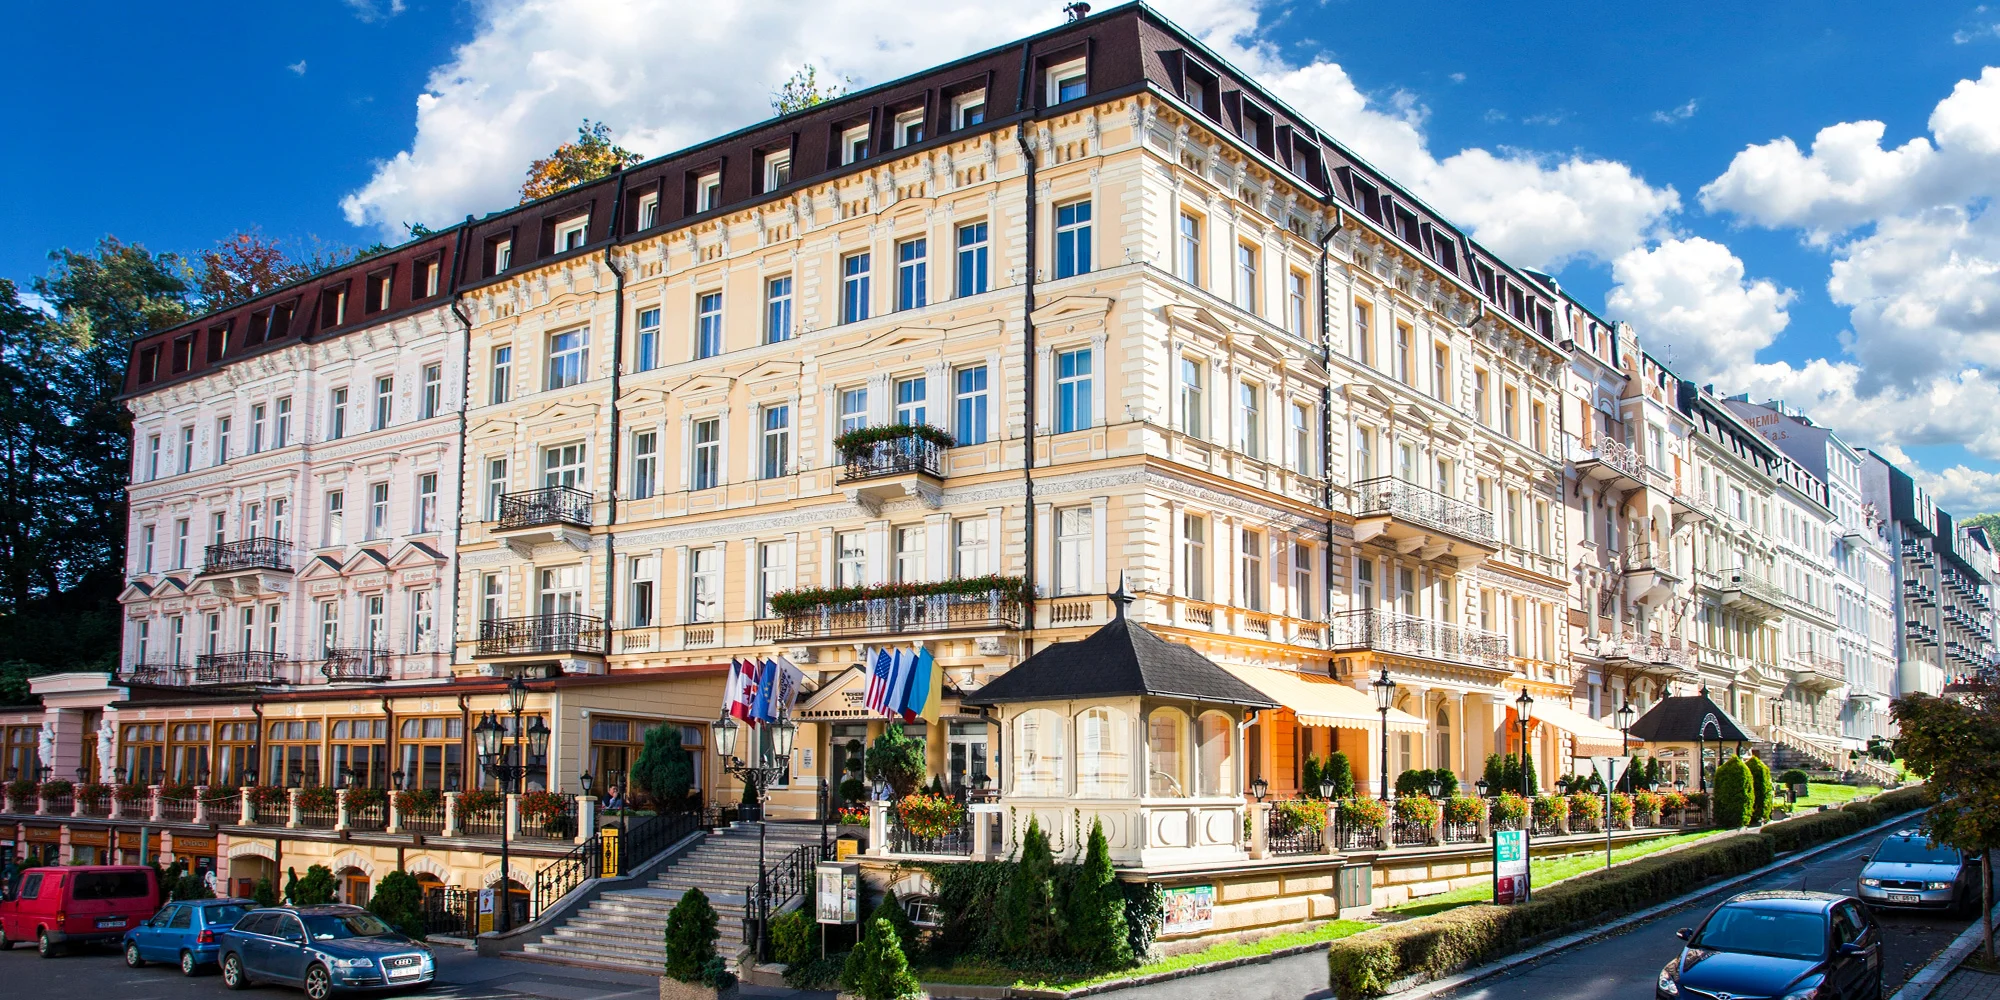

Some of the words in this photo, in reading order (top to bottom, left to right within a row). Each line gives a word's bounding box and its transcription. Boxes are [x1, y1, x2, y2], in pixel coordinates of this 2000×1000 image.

[1744, 413, 1780, 428] HEMIA
[800, 709, 869, 717] SANATORIUM
[484, 870, 531, 888] KAVRNA
